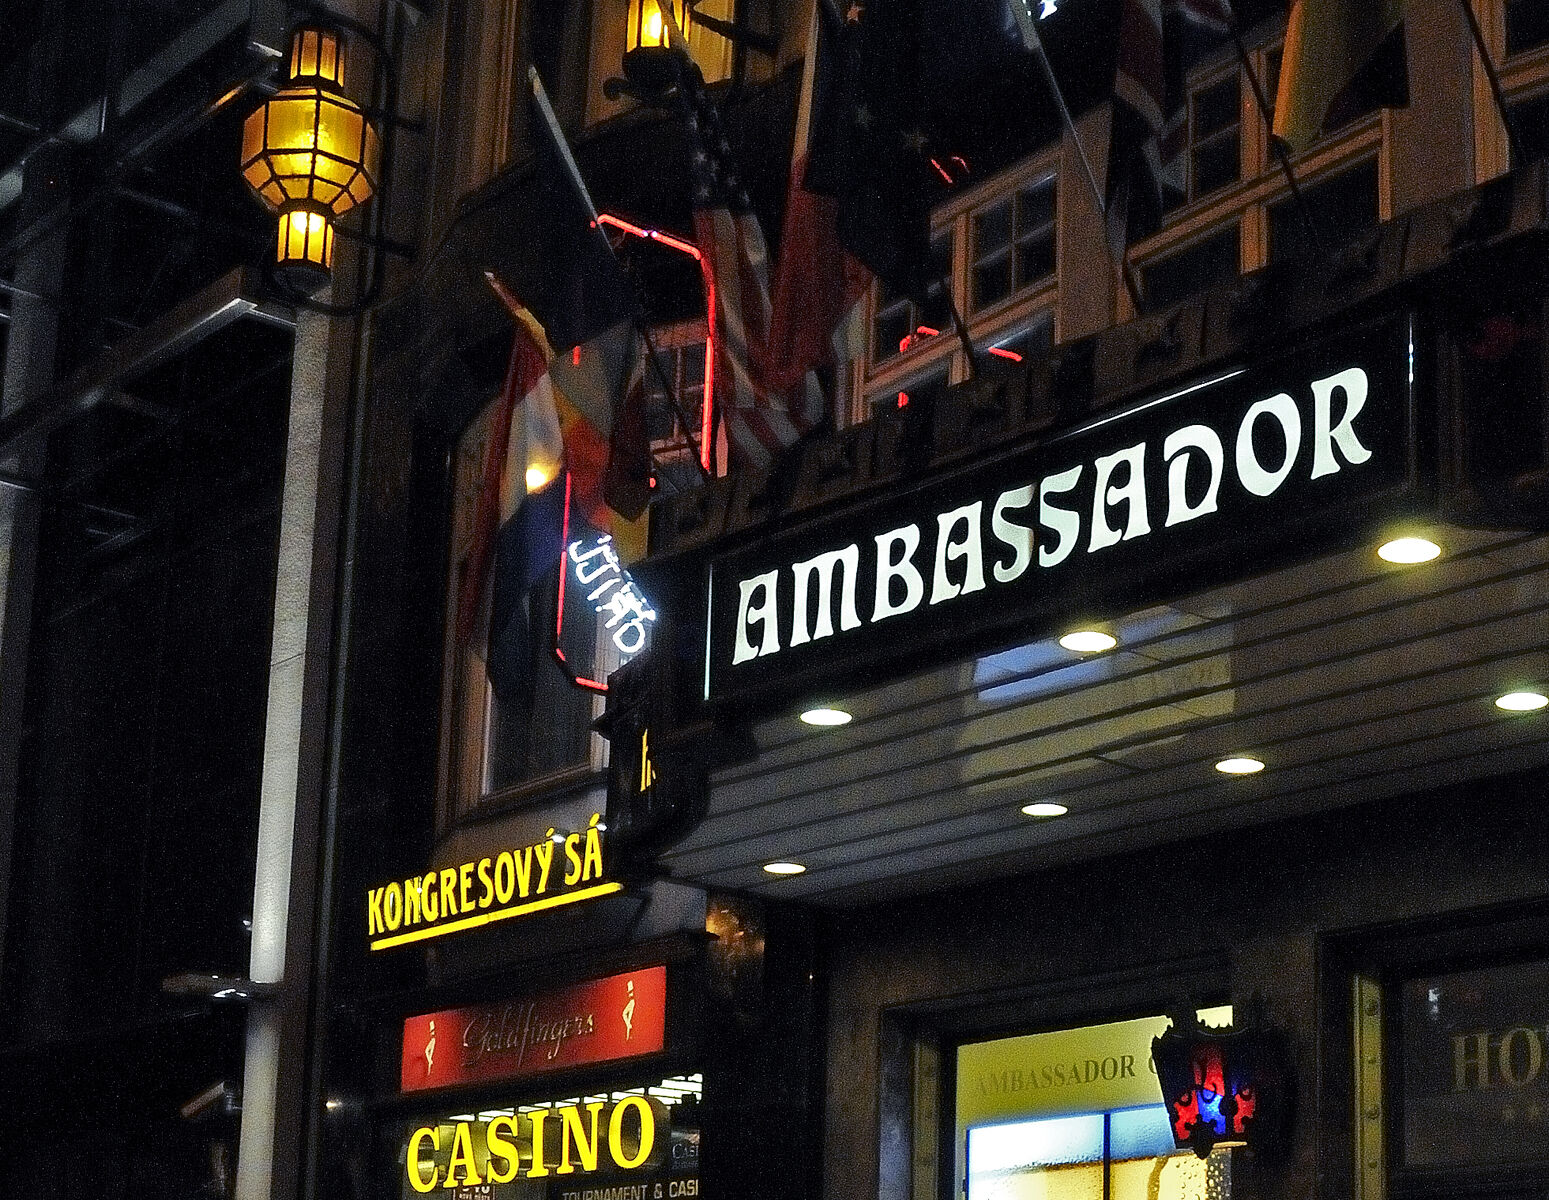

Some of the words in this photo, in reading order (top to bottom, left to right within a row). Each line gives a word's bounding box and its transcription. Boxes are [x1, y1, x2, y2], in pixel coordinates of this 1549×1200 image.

[732, 367, 1373, 666] AMBASSADOR
[368, 828, 554, 935] KONGRESOVÝ
[462, 1003, 594, 1067] Goldfingers
[1451, 1027, 1549, 1093] HO
[978, 1055, 1136, 1096] AMBASSADOR
[407, 1095, 656, 1193] CASINO
[654, 1183, 663, 1199] &
